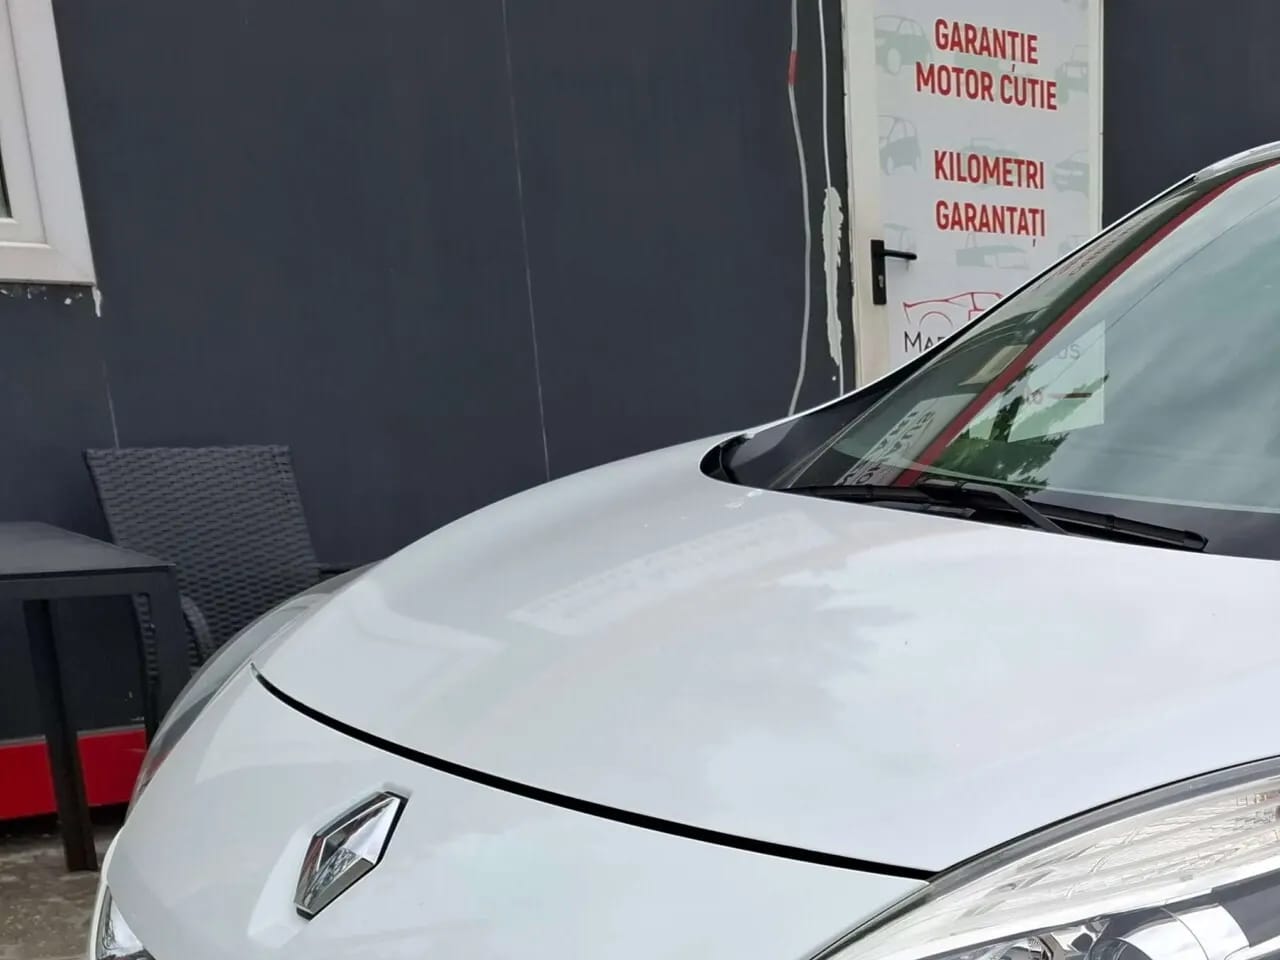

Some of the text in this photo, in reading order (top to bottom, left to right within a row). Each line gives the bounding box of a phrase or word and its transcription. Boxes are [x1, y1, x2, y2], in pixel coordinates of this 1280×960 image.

[935, 19, 1038, 72] GARANȚIE
[916, 62, 1057, 110] MOTOR CUTIE
[934, 150, 1044, 189] KILOMETRI
[936, 200, 1045, 247] GARANTAȚI
